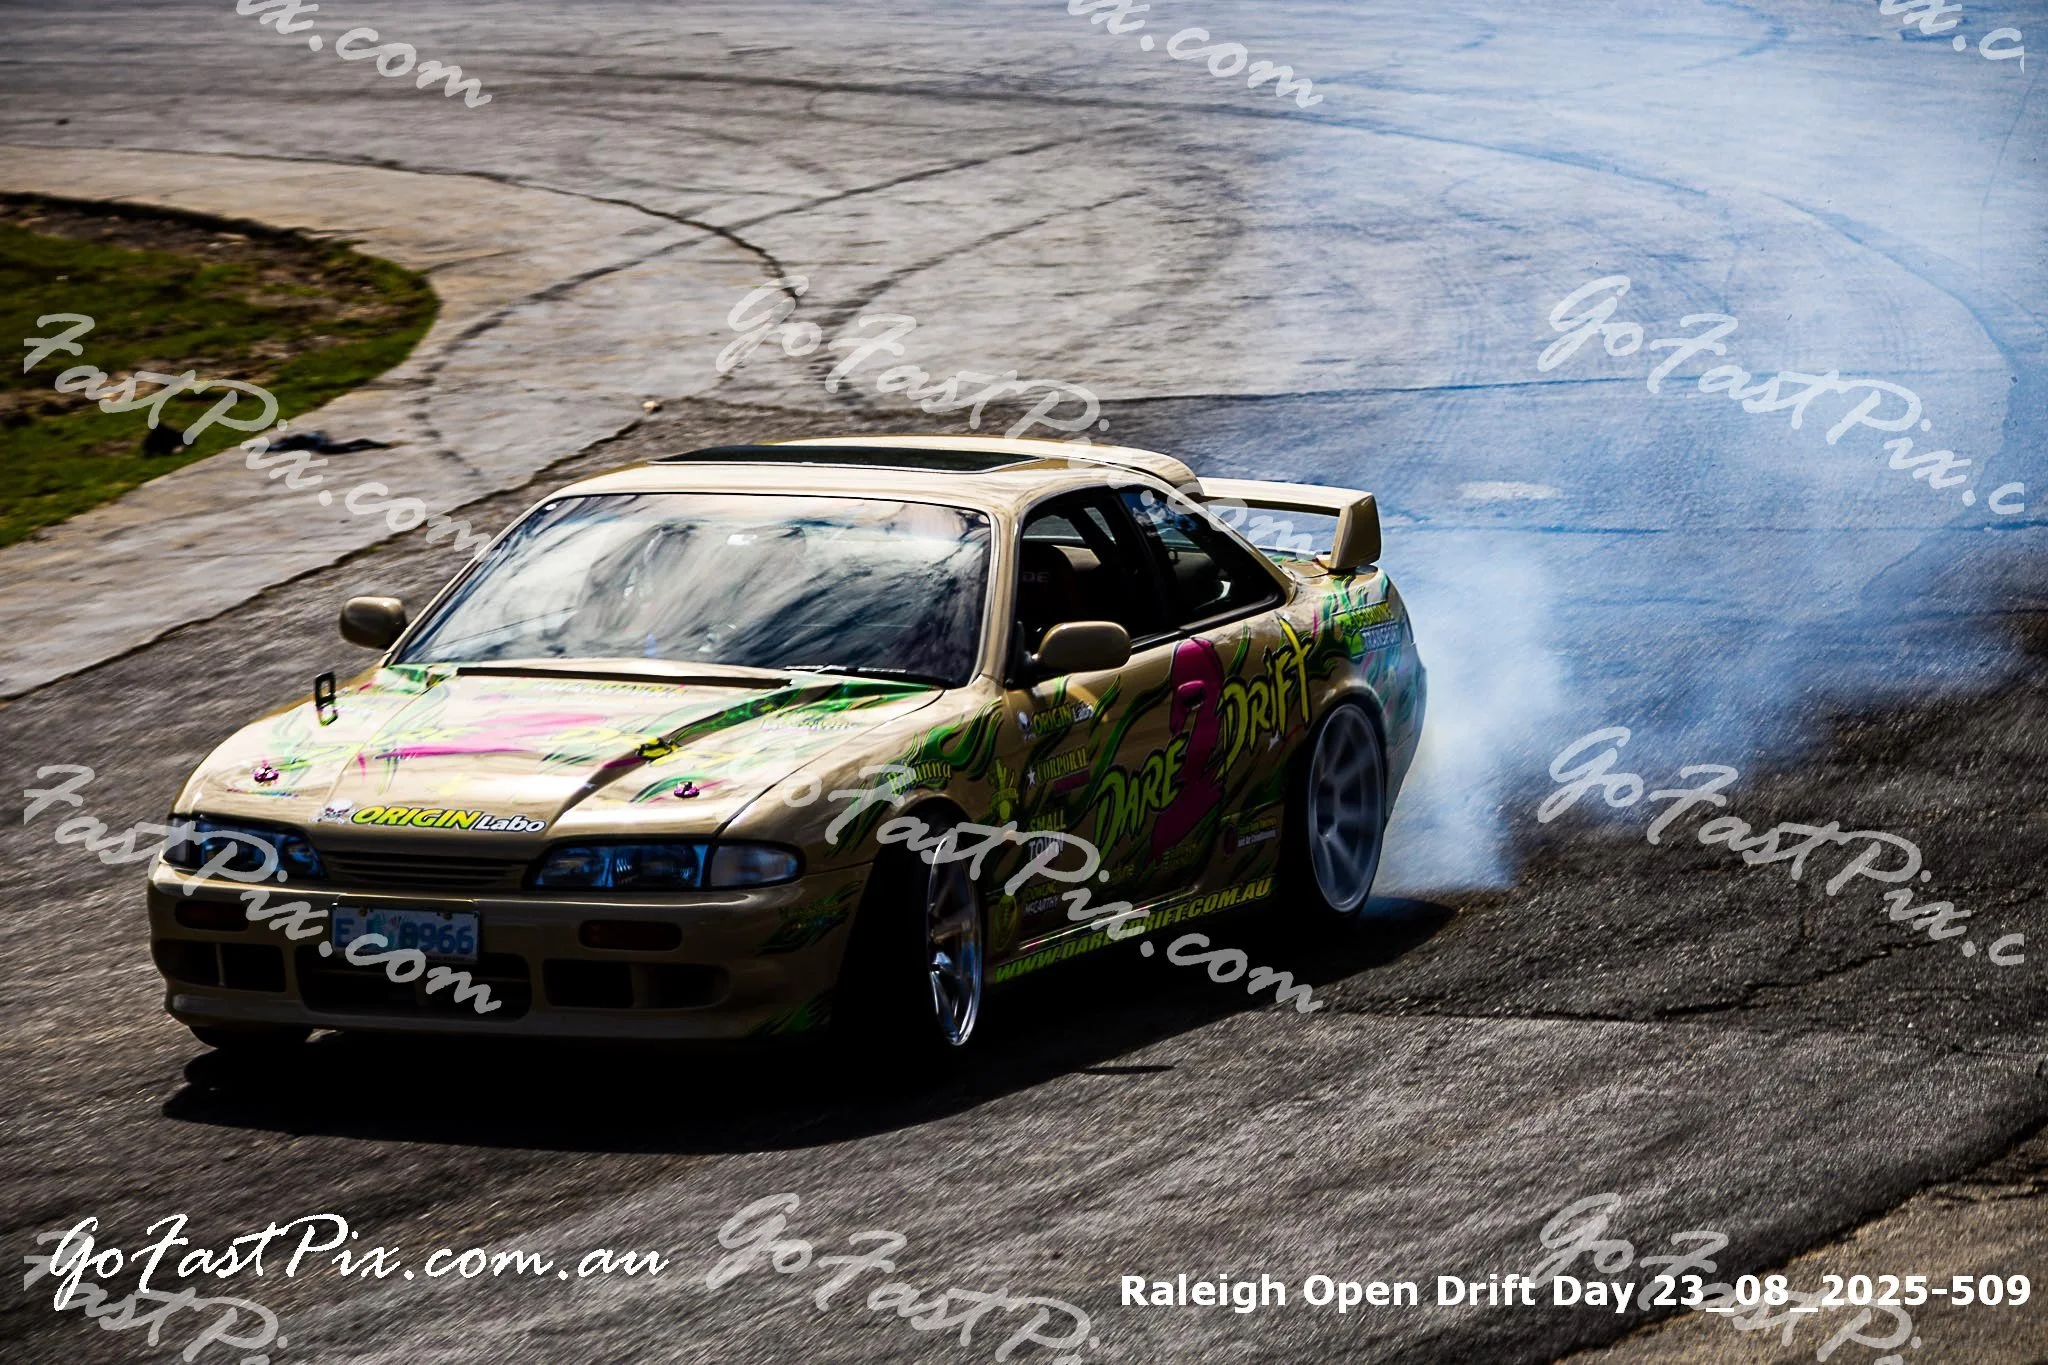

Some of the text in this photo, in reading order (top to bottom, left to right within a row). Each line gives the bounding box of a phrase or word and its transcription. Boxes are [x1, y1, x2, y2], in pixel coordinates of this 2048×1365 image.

[1032, 704, 1072, 734] ORIGIN
[1094, 733, 1187, 866] DARE
[1214, 612, 1313, 782] DRIFT
[350, 804, 546, 834] ORIGIN Labo
[1029, 808, 1067, 831] SMALL
[994, 876, 1273, 984] WWW.DAREDRIFT.COM.AU
